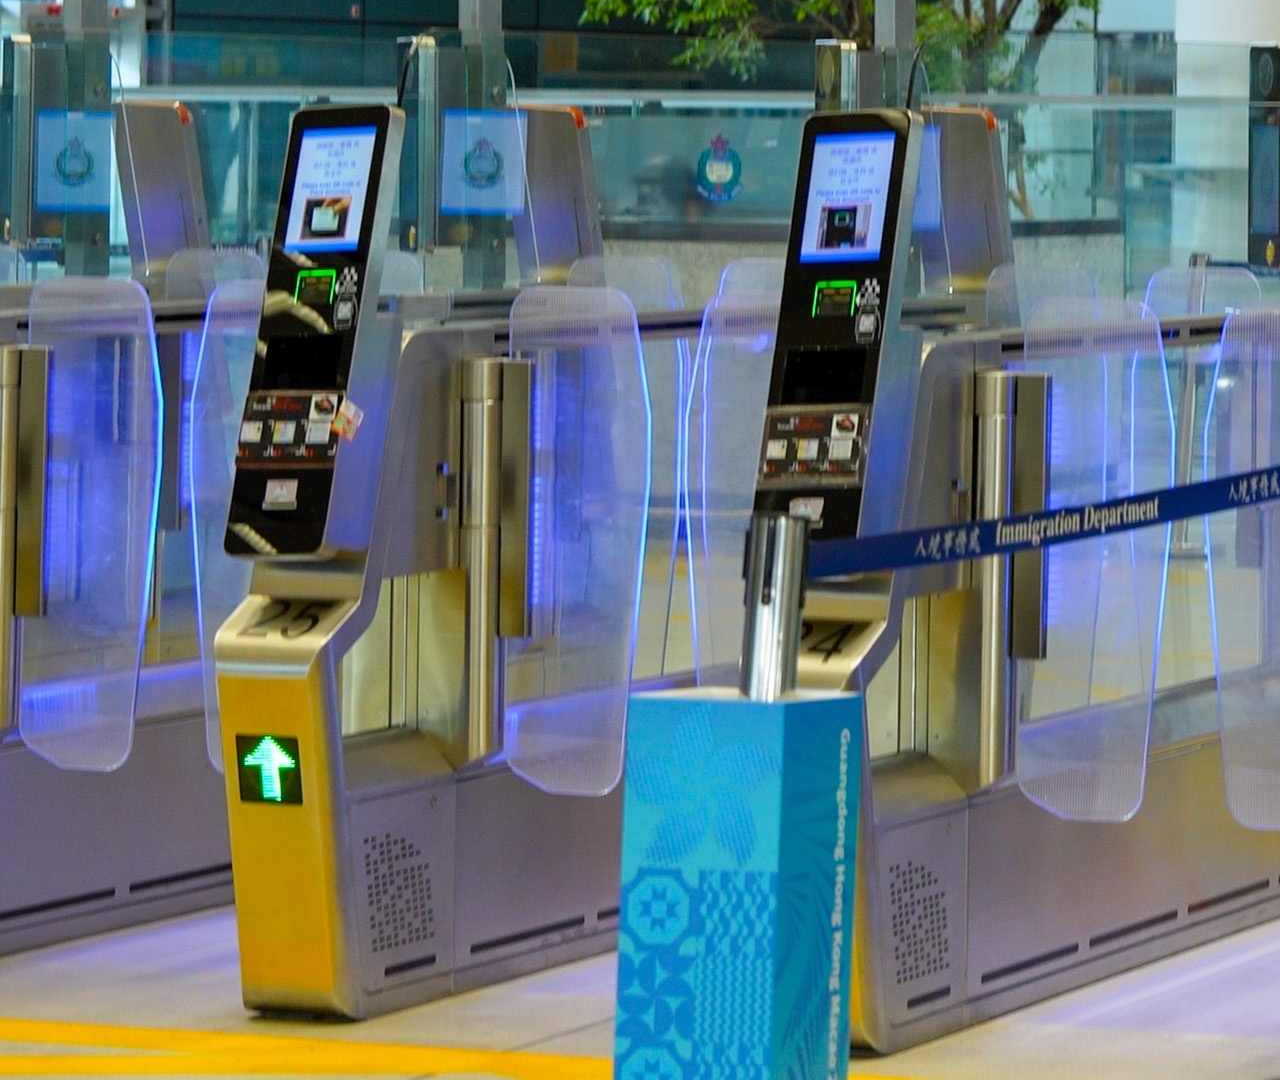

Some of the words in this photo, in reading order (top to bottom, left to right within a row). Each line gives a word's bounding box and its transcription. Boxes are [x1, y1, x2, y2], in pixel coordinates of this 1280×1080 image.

[995, 507, 1081, 547] Immigration
[1083, 494, 1160, 534] Department
[238, 600, 335, 639] 25
[833, 728, 850, 862] Guangdong
[830, 864, 846, 928] Hong
[828, 930, 844, 993] Kong
[828, 994, 842, 1070] Macao
